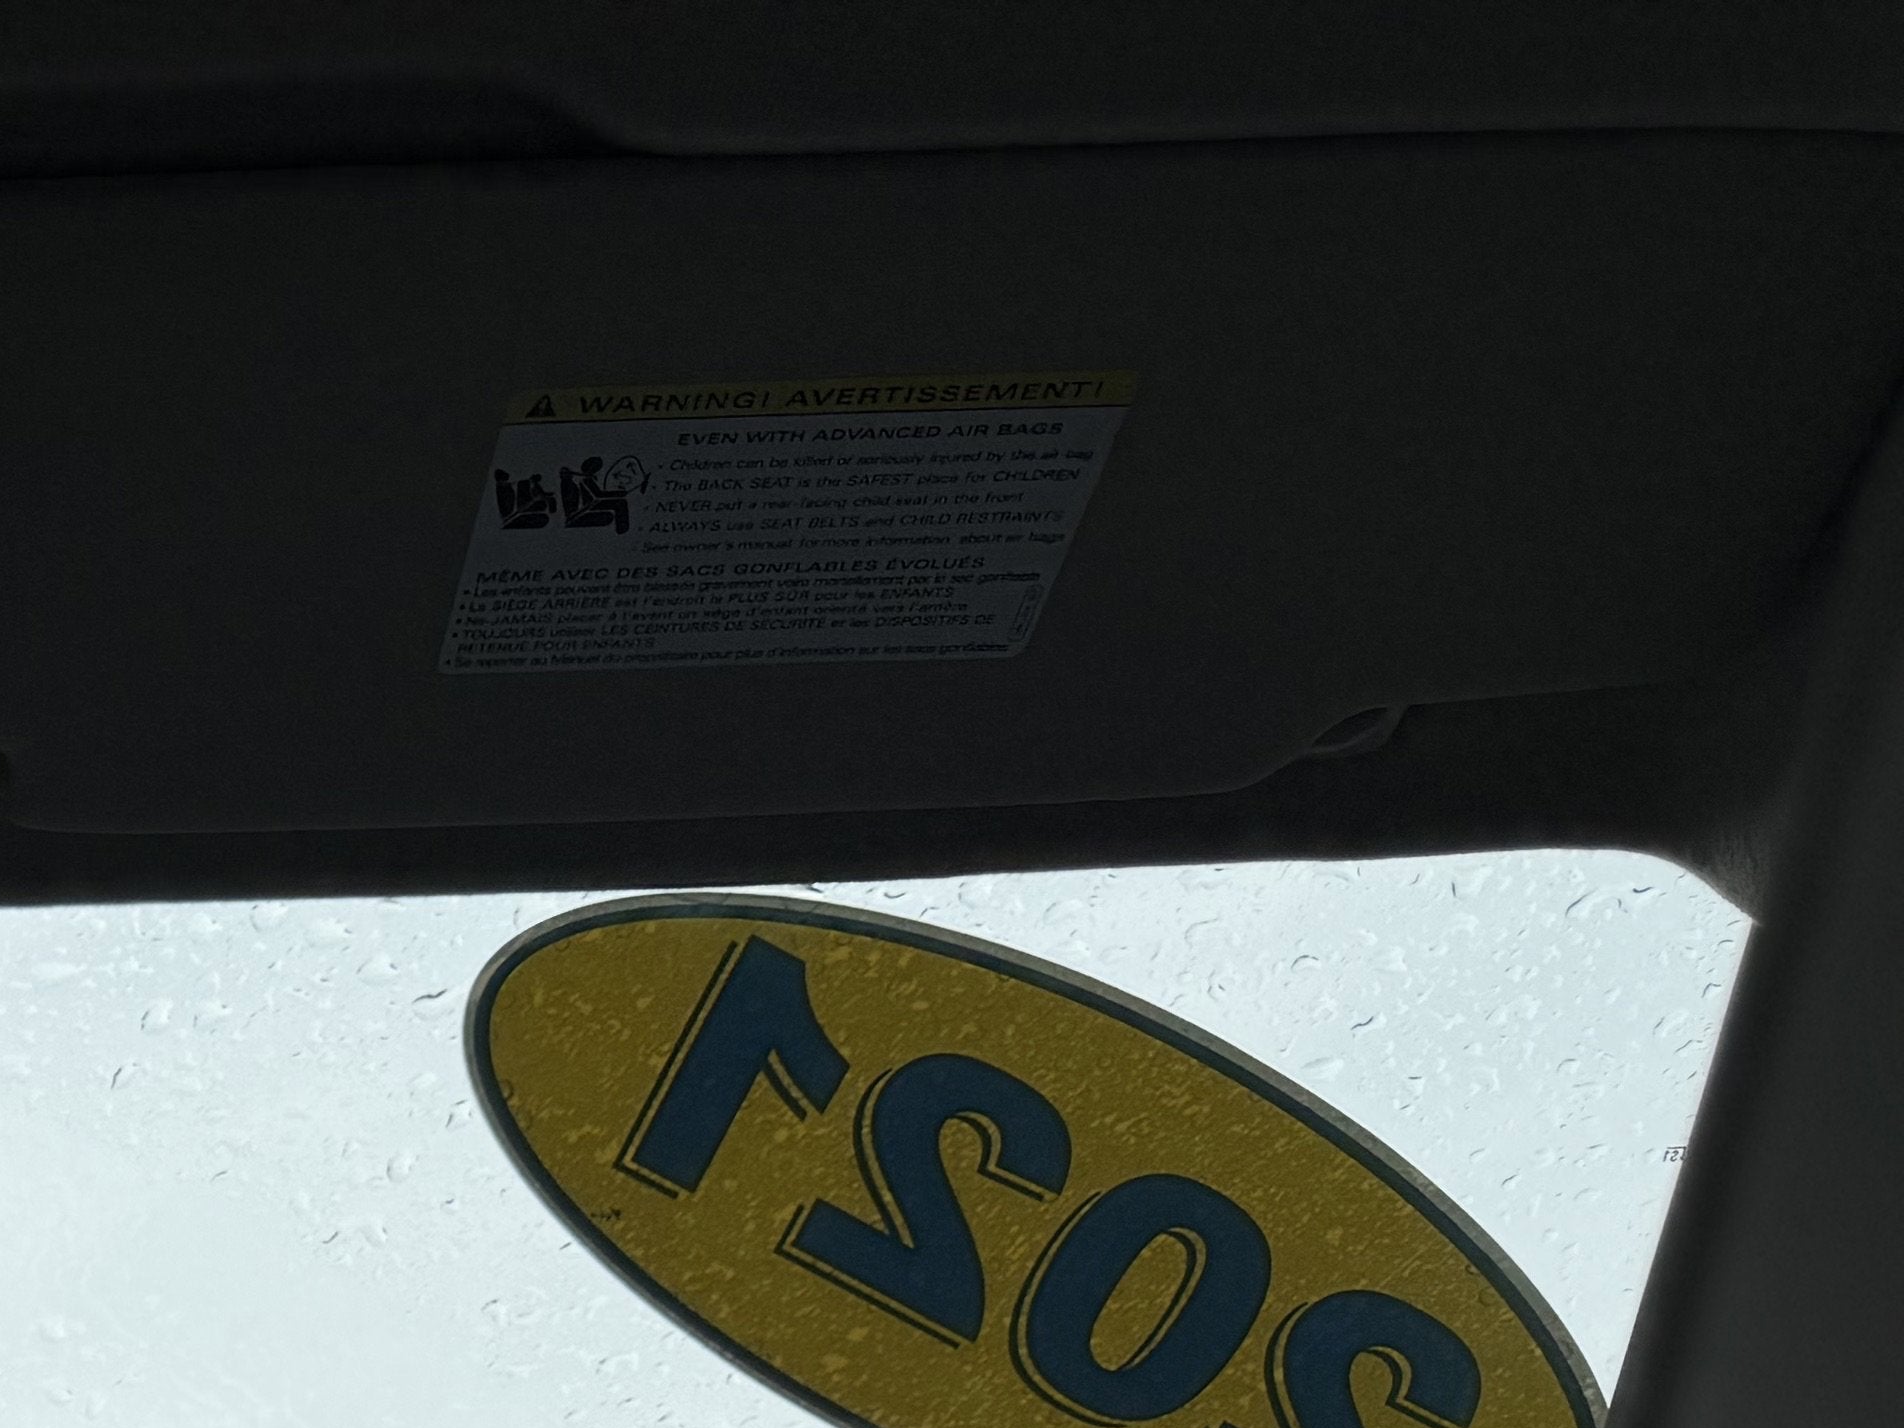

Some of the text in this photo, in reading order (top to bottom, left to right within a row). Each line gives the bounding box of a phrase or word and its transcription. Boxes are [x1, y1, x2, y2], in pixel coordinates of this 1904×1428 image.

[578, 379, 1106, 416] WARNING! AVERTISSEMENT!
[677, 422, 1065, 445] EVEN WITH ADVANCED AIR BAGS
[551, 566, 610, 580] AVEC
[616, 565, 659, 579] DES
[664, 563, 726, 577] SACS
